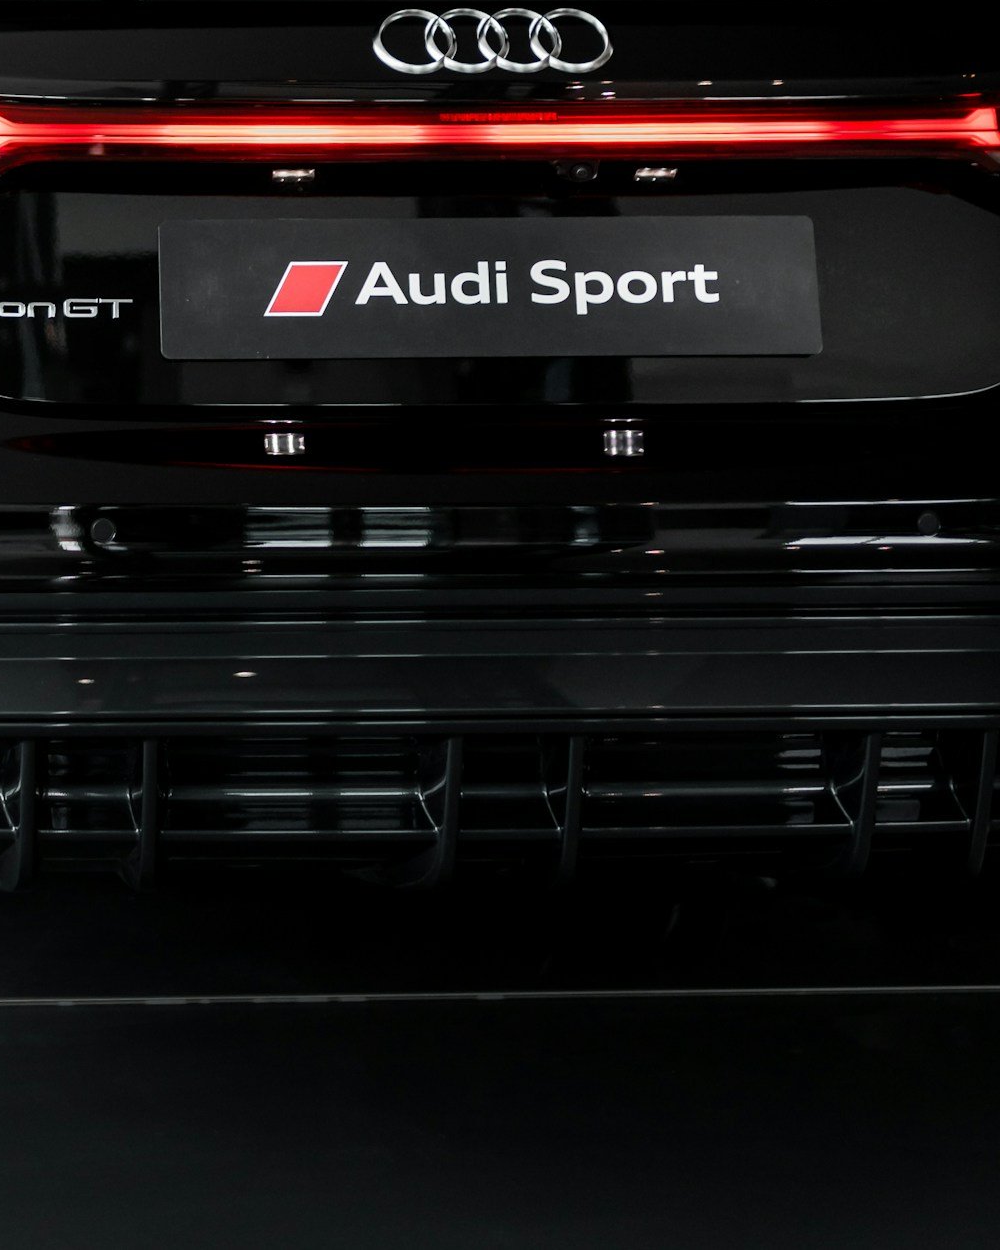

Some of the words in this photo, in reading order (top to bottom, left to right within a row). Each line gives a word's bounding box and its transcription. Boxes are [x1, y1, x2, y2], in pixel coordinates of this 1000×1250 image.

[354, 261, 509, 306] Audi
[529, 260, 720, 316] Sport
[62, 297, 134, 320] GT
